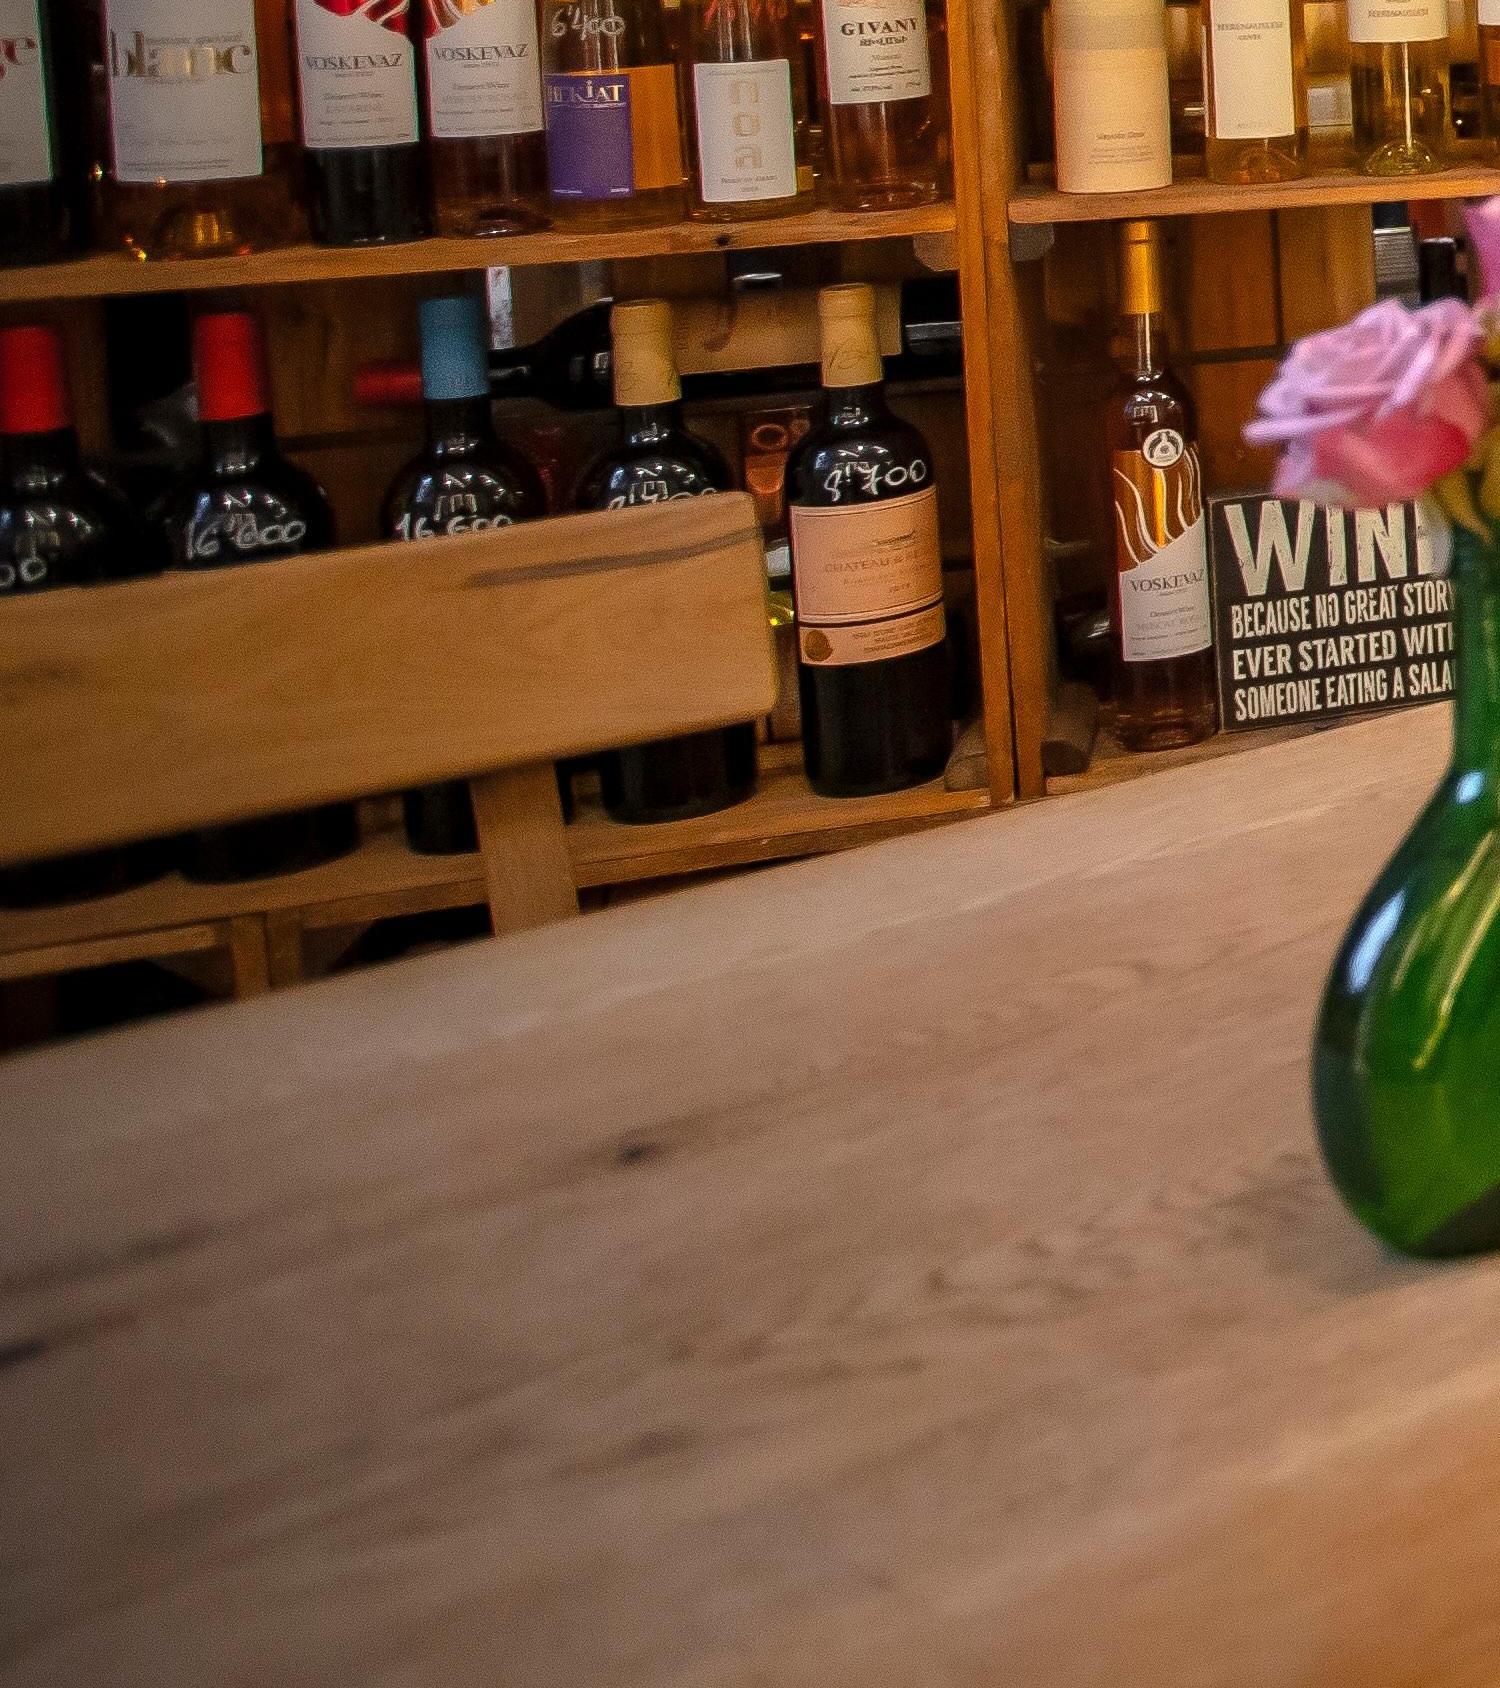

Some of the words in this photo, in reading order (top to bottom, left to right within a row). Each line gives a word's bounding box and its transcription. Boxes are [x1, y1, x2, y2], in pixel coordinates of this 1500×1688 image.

[304, 51, 404, 72] VOSKEVAZ
[432, 44, 530, 64] VOSKEVAZ
[1231, 596, 1312, 641] BECAUSE
[1315, 593, 1340, 628] NO
[1343, 583, 1398, 626] GREAT
[1233, 642, 1294, 681] EVER
[1298, 630, 1397, 676] STARTED
[1233, 678, 1323, 723] SOMEONE
[1325, 666, 1389, 708] EATING
[1392, 663, 1406, 698] A
[1409, 658, 1456, 694] SALA
